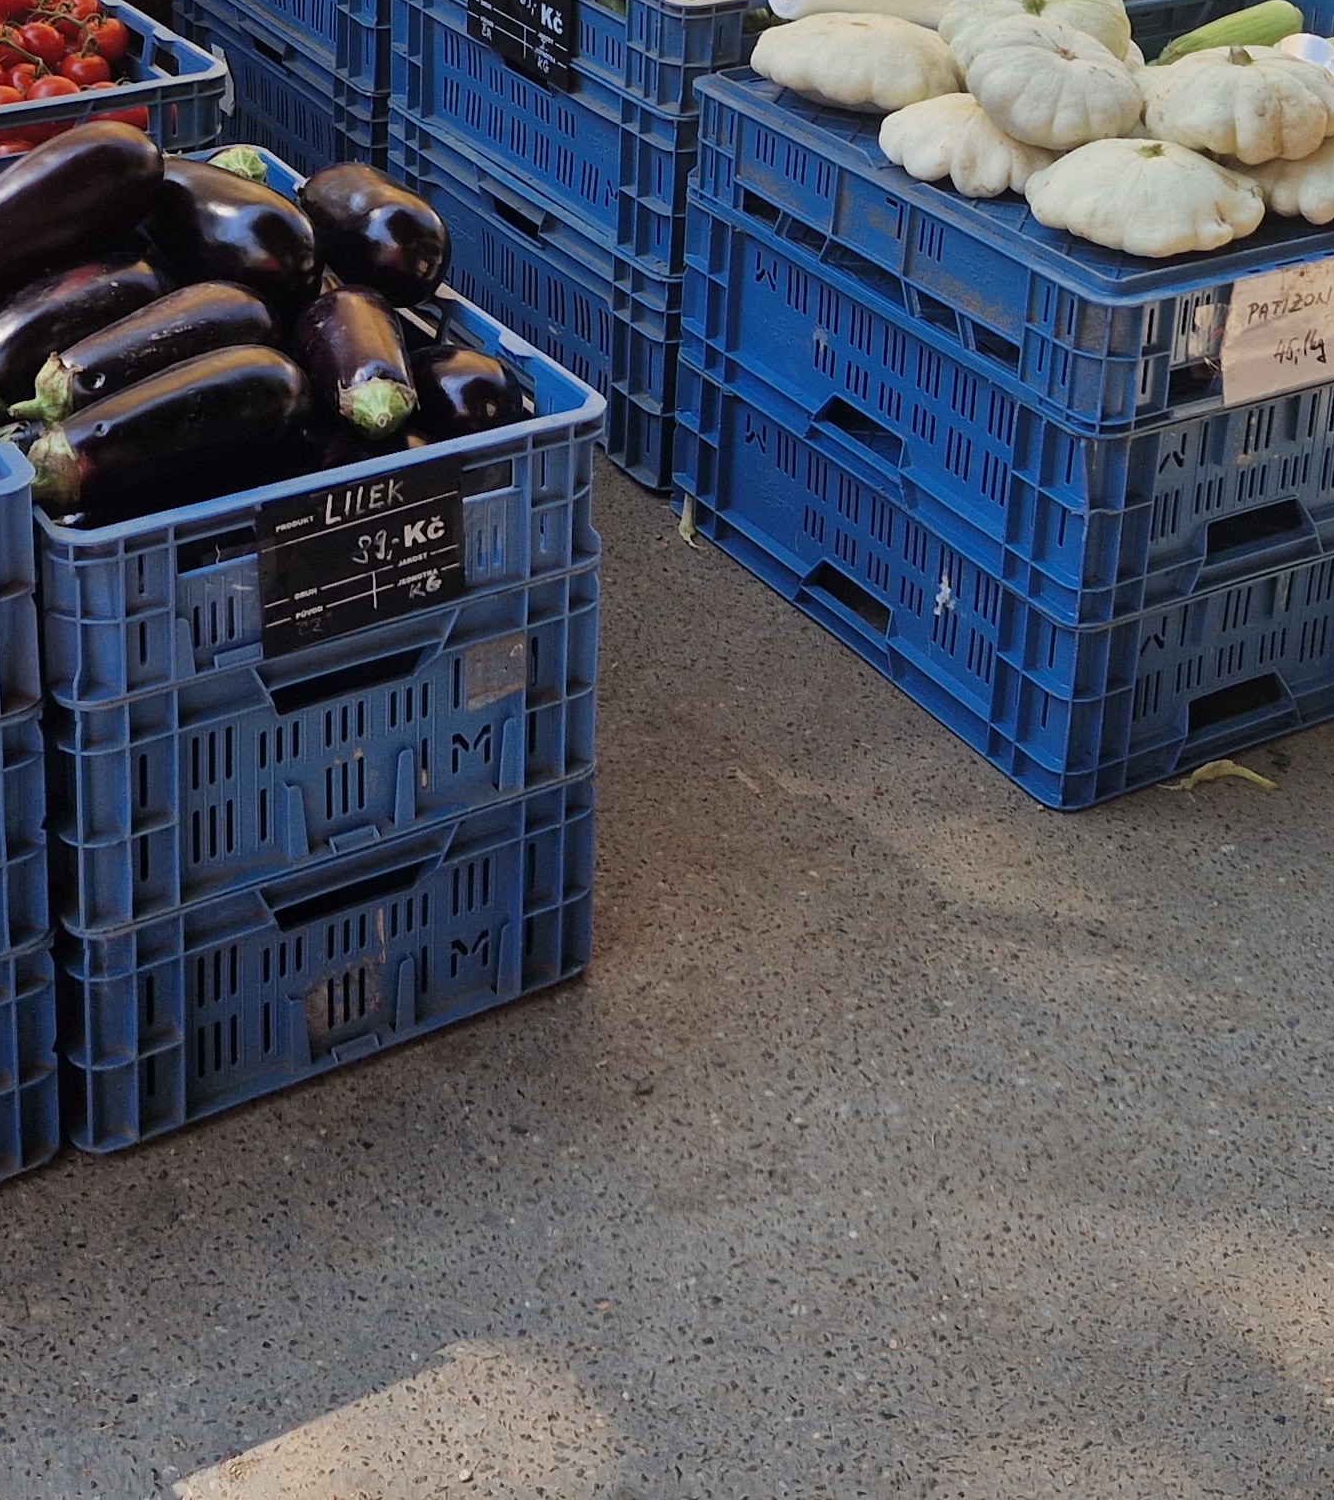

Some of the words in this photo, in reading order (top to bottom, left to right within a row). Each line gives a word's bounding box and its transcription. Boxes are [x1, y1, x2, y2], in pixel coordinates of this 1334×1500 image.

[541, 3, 564, 35] Kč
[1247, 287, 1333, 325] PATIZON
[275, 515, 315, 533] PRODUKT
[325, 479, 404, 525] LILEK
[404, 515, 446, 548] Kč
[409, 575, 442, 599] KG
